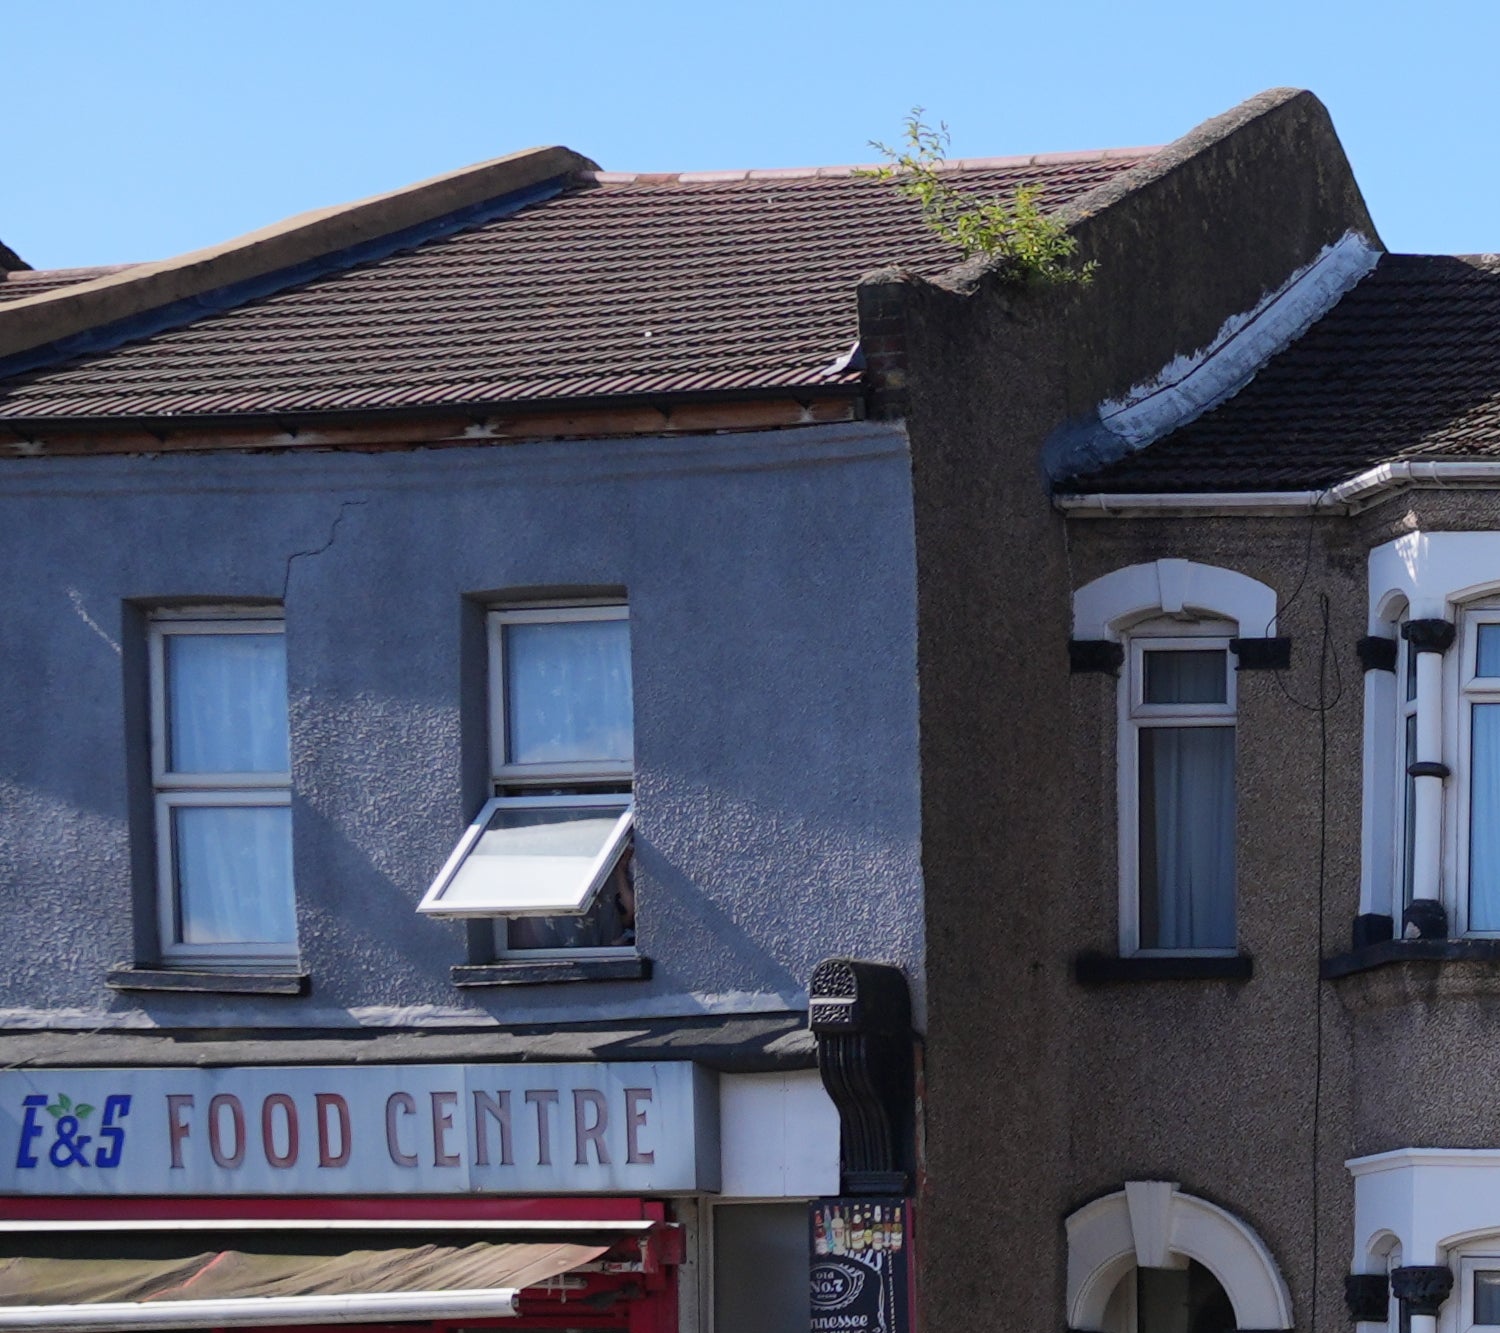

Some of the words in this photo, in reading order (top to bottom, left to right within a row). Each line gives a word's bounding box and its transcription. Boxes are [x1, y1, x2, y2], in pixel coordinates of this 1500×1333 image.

[15, 1093, 133, 1170] E&S
[165, 1092, 352, 1170] FOOD
[385, 1087, 656, 1169] CENTRE
